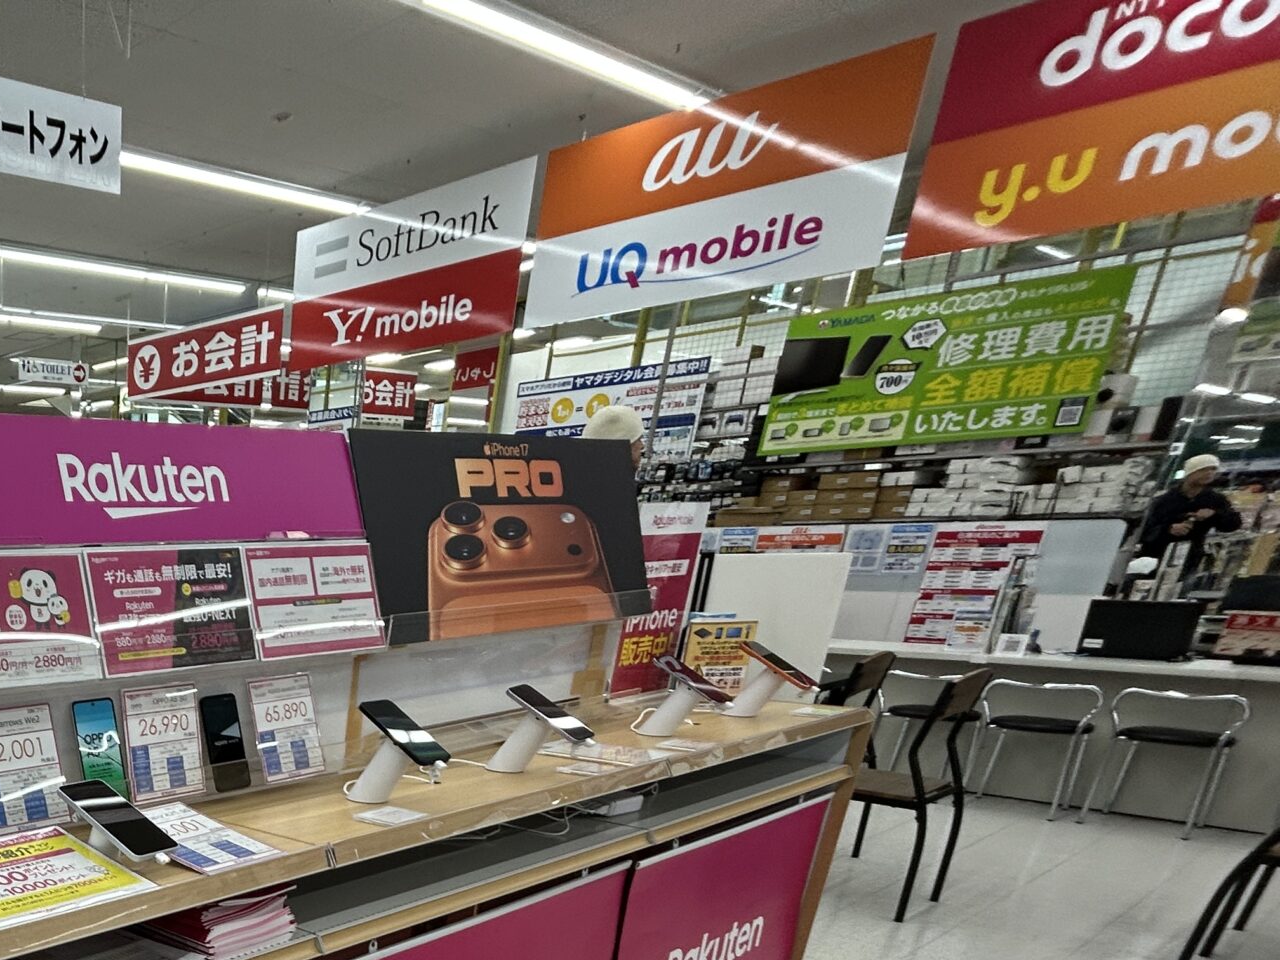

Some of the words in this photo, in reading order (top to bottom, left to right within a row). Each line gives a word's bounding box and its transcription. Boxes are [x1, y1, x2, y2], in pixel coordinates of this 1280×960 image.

[642, 110, 779, 192] au
[974, 148, 1098, 228] y.u
[1118, 111, 1280, 182] mo
[356, 195, 500, 268] SoftBank
[576, 242, 648, 293] UQ
[656, 213, 823, 275] mobile
[324, 305, 372, 349] Y!
[376, 295, 473, 338] mobile
[937, 313, 1116, 368] 修理費用
[40, 362, 72, 377] TOILET
[171, 320, 275, 378] お会計
[921, 357, 1102, 406] 全額補償
[914, 402, 1047, 434] いたします。
[491, 443, 519, 457] iPhone
[56, 451, 230, 510] Rakuten
[455, 458, 564, 498] PRO
[104, 562, 233, 585] ギガも通話も無制限で最安!
[138, 713, 189, 737] 26,990
[265, 701, 308, 723] 65,890
